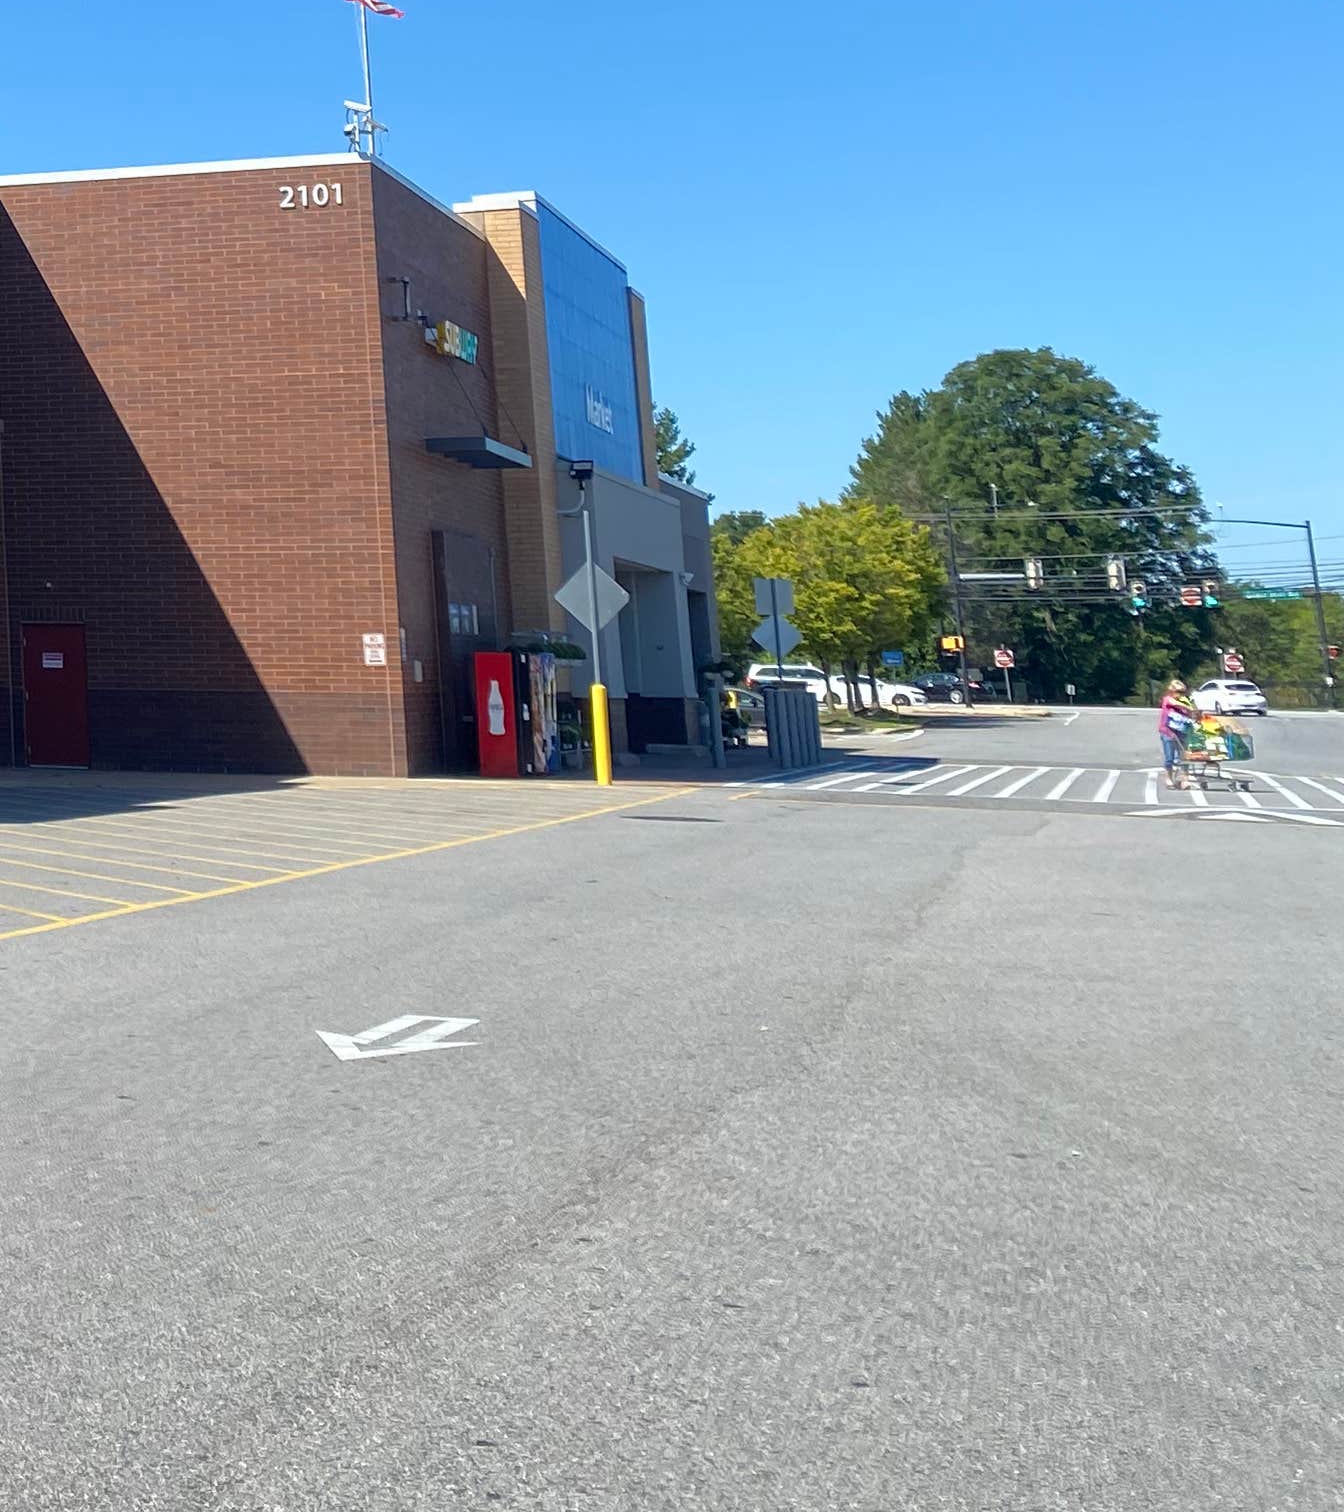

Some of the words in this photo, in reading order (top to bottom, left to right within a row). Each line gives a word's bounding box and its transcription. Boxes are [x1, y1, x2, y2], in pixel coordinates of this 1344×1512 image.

[278, 182, 343, 209] 2101
[443, 319, 479, 365] SUBWAY
[585, 383, 614, 435] Market
